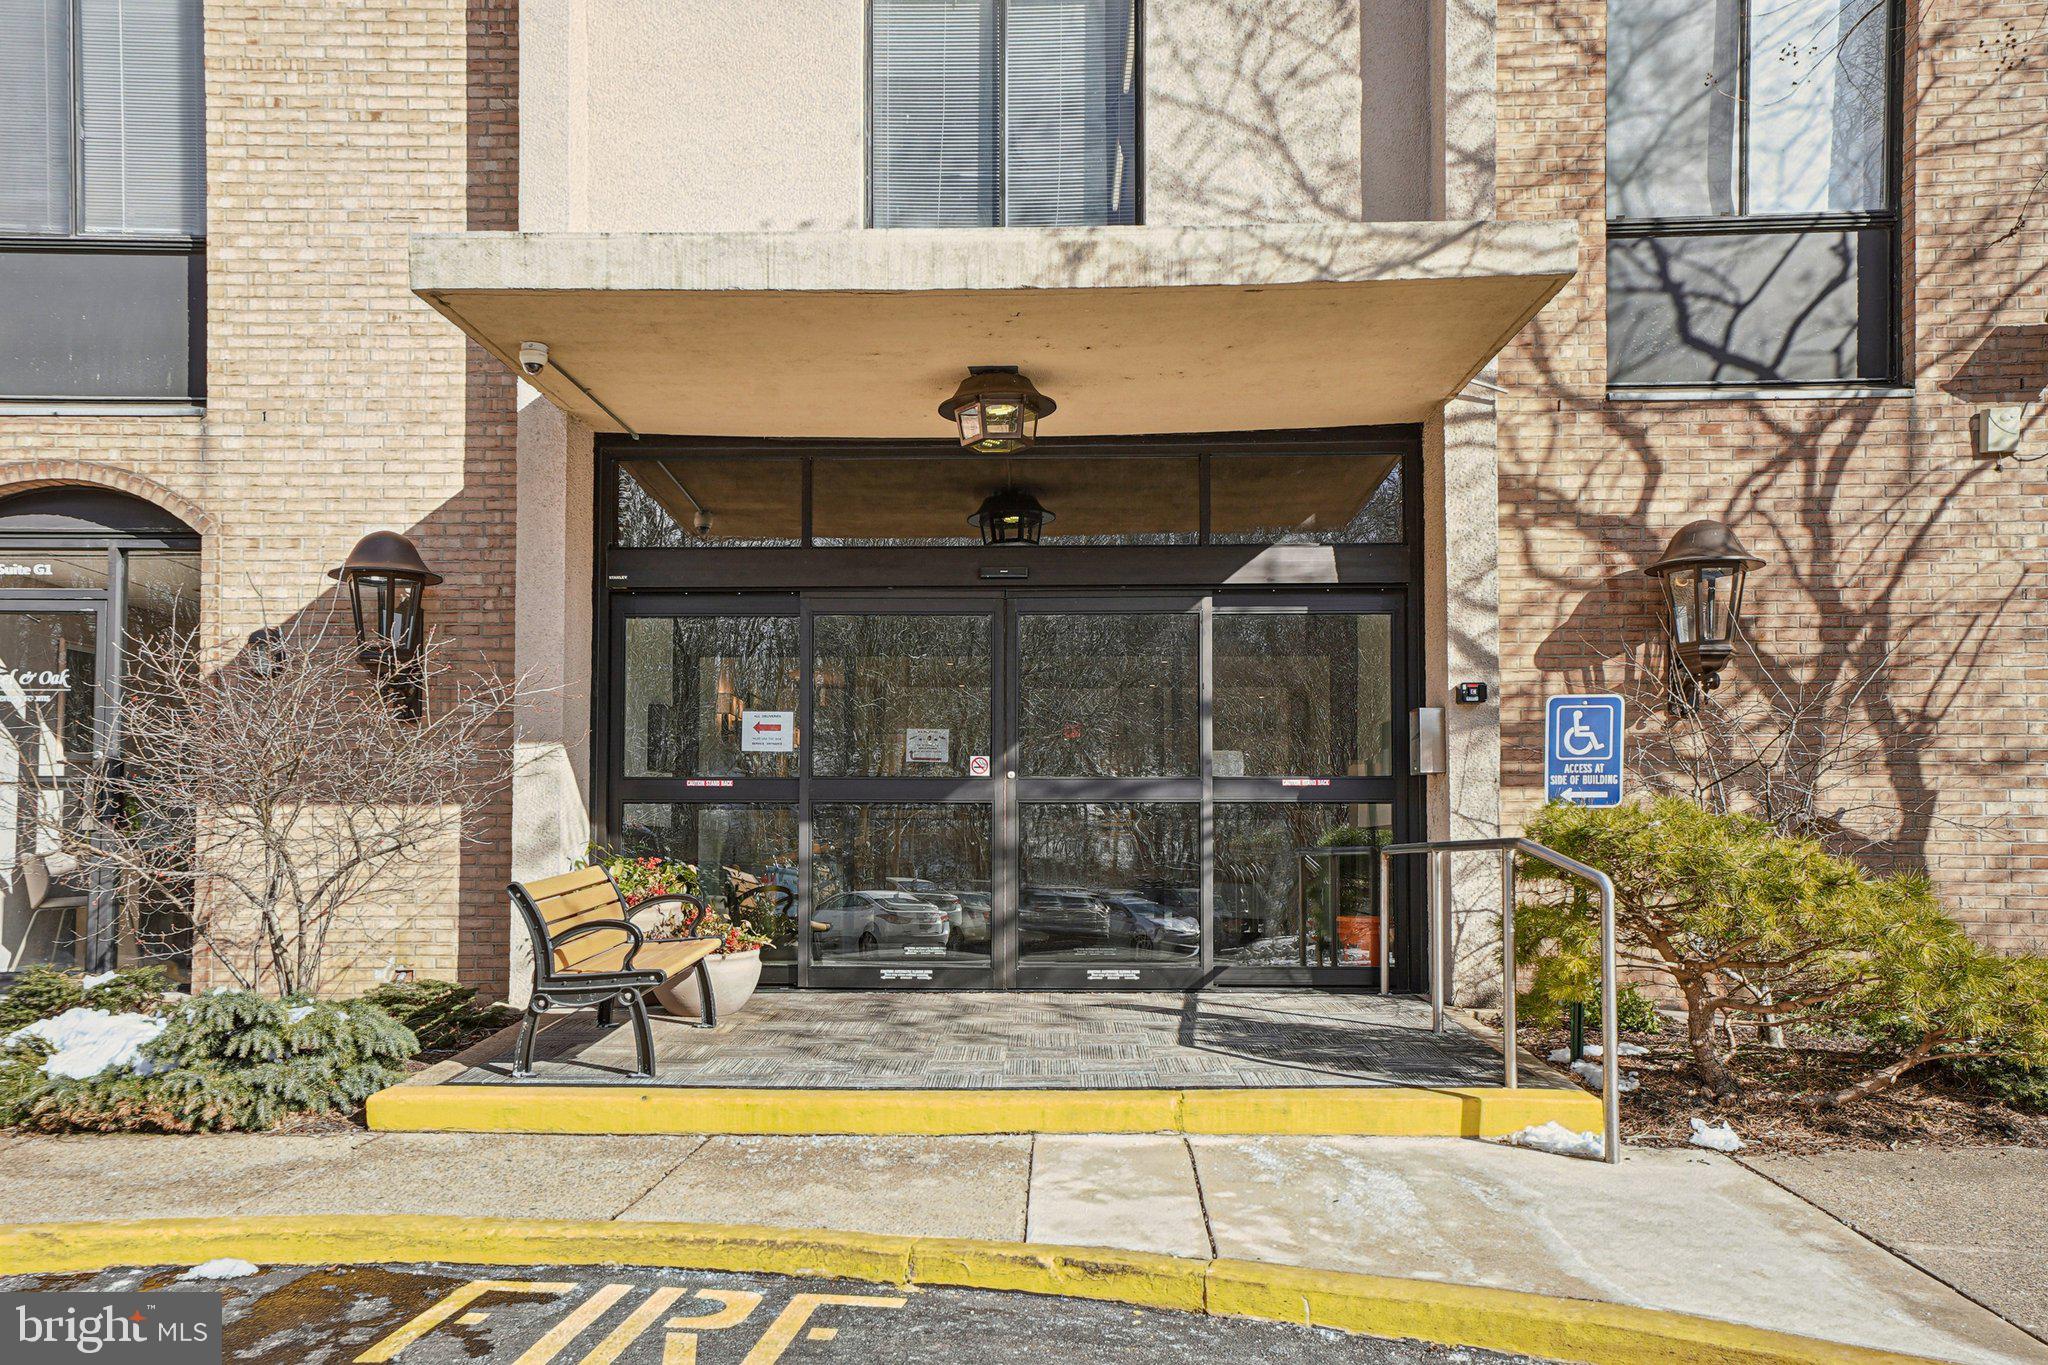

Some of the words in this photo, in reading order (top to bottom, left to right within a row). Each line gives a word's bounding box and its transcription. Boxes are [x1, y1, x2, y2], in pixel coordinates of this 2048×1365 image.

[38, 668, 72, 688] Oak
[1564, 763, 1593, 774] ACCESS
[1594, 763, 1605, 774] AT
[1550, 775, 1568, 785] SIDE
[1569, 775, 1579, 785] OF
[1582, 775, 1619, 785] BUILDING
[351, 1280, 908, 1365] FIRE
